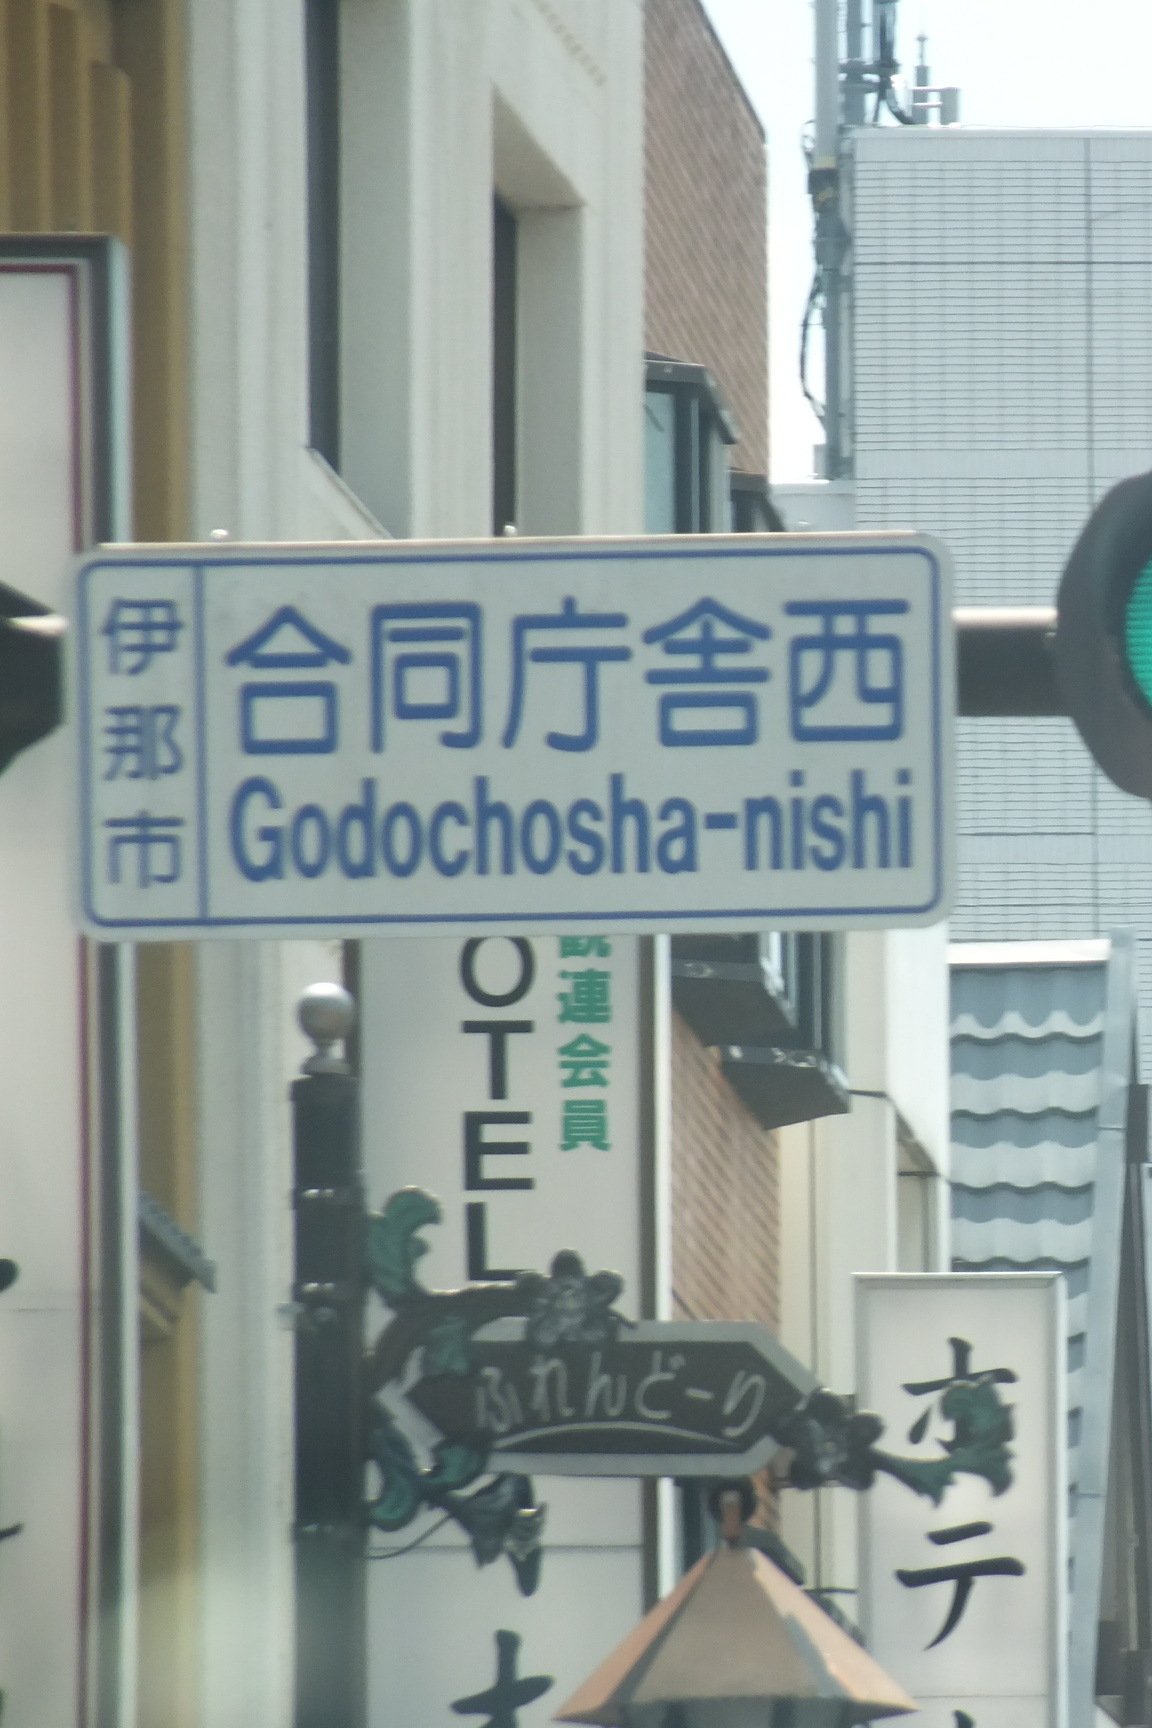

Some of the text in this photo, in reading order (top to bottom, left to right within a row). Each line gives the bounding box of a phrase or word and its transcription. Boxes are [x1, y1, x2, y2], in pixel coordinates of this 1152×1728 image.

[101, 597, 186, 889] 伊那市
[225, 596, 912, 755] 合同庁舎西
[229, 769, 914, 884] Godochosha-nishi
